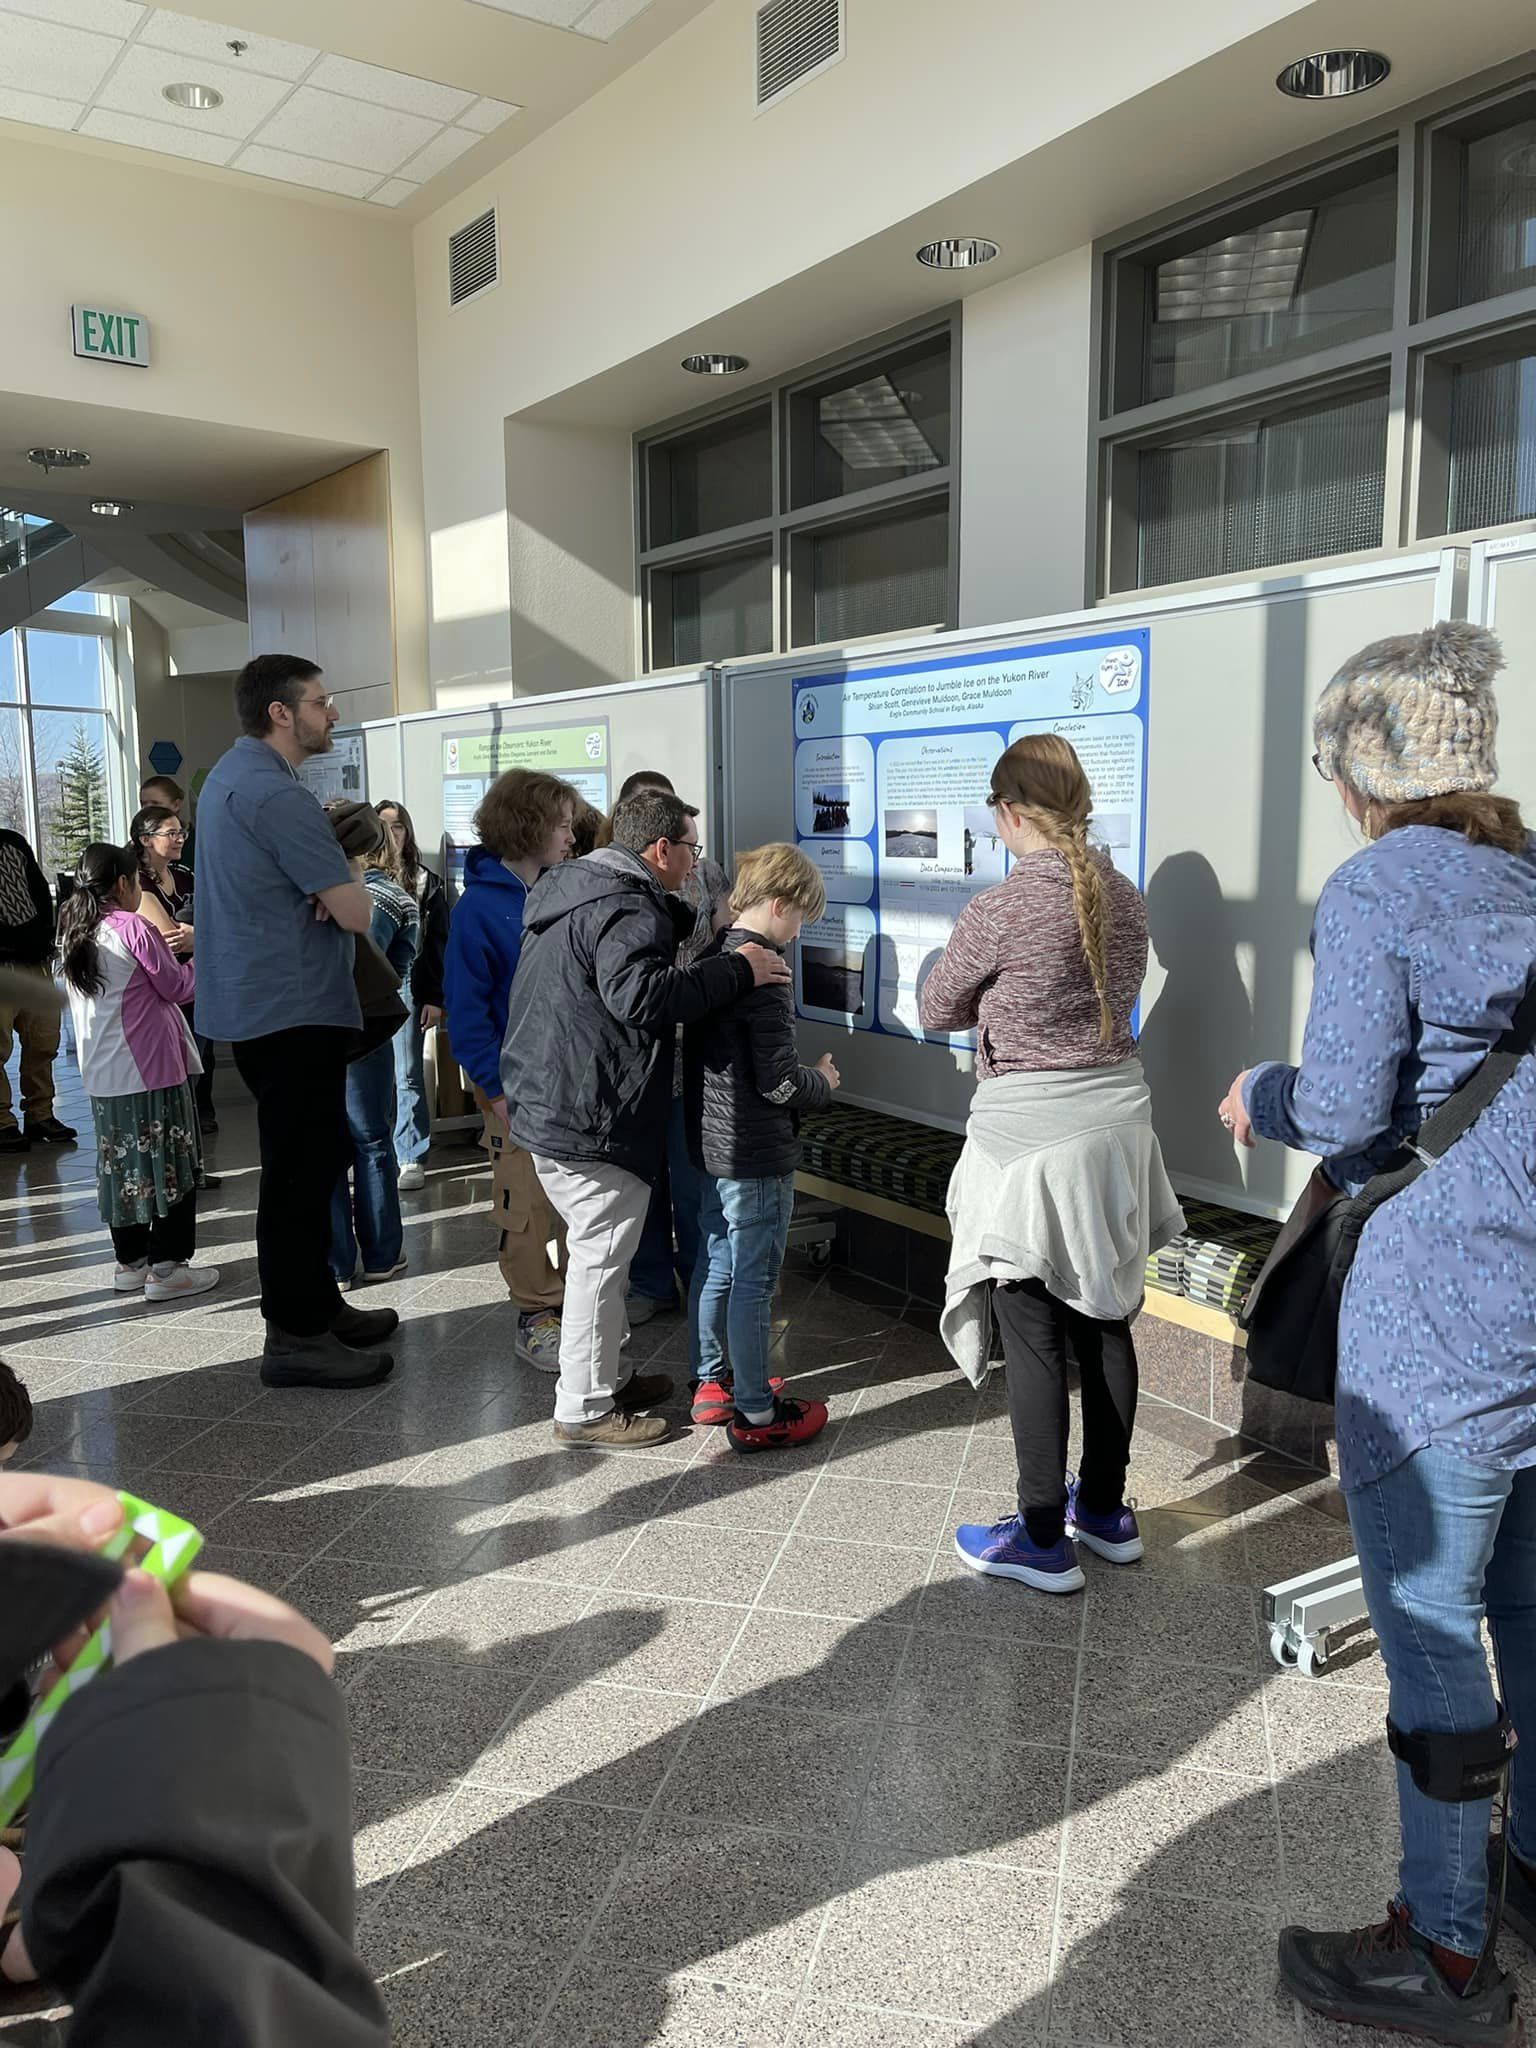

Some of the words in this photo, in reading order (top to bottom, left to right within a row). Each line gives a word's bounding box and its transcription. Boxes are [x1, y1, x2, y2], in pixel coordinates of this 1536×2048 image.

[83, 310, 139, 358] EXIT
[842, 692, 851, 701] Air
[852, 690, 889, 701] Temperature
[890, 685, 926, 696] Correlation
[927, 684, 935, 692] to
[936, 680, 961, 691] Jumble
[963, 678, 974, 688] Ice
[976, 678, 986, 686] on
[988, 675, 1000, 685] the
[1002, 672, 1026, 683] Yukon
[1028, 670, 1050, 681] River
[1117, 678, 1129, 687] Ice
[901, 698, 931, 707] Genevieve
[932, 694, 960, 704] Muldoon,
[962, 691, 981, 700] Grace
[982, 688, 1012, 698] Muldoon
[902, 708, 928, 717] Community
[1053, 722, 1085, 733] Conclusion
[920, 863, 933, 872] Data
[934, 863, 963, 874] Comparison
